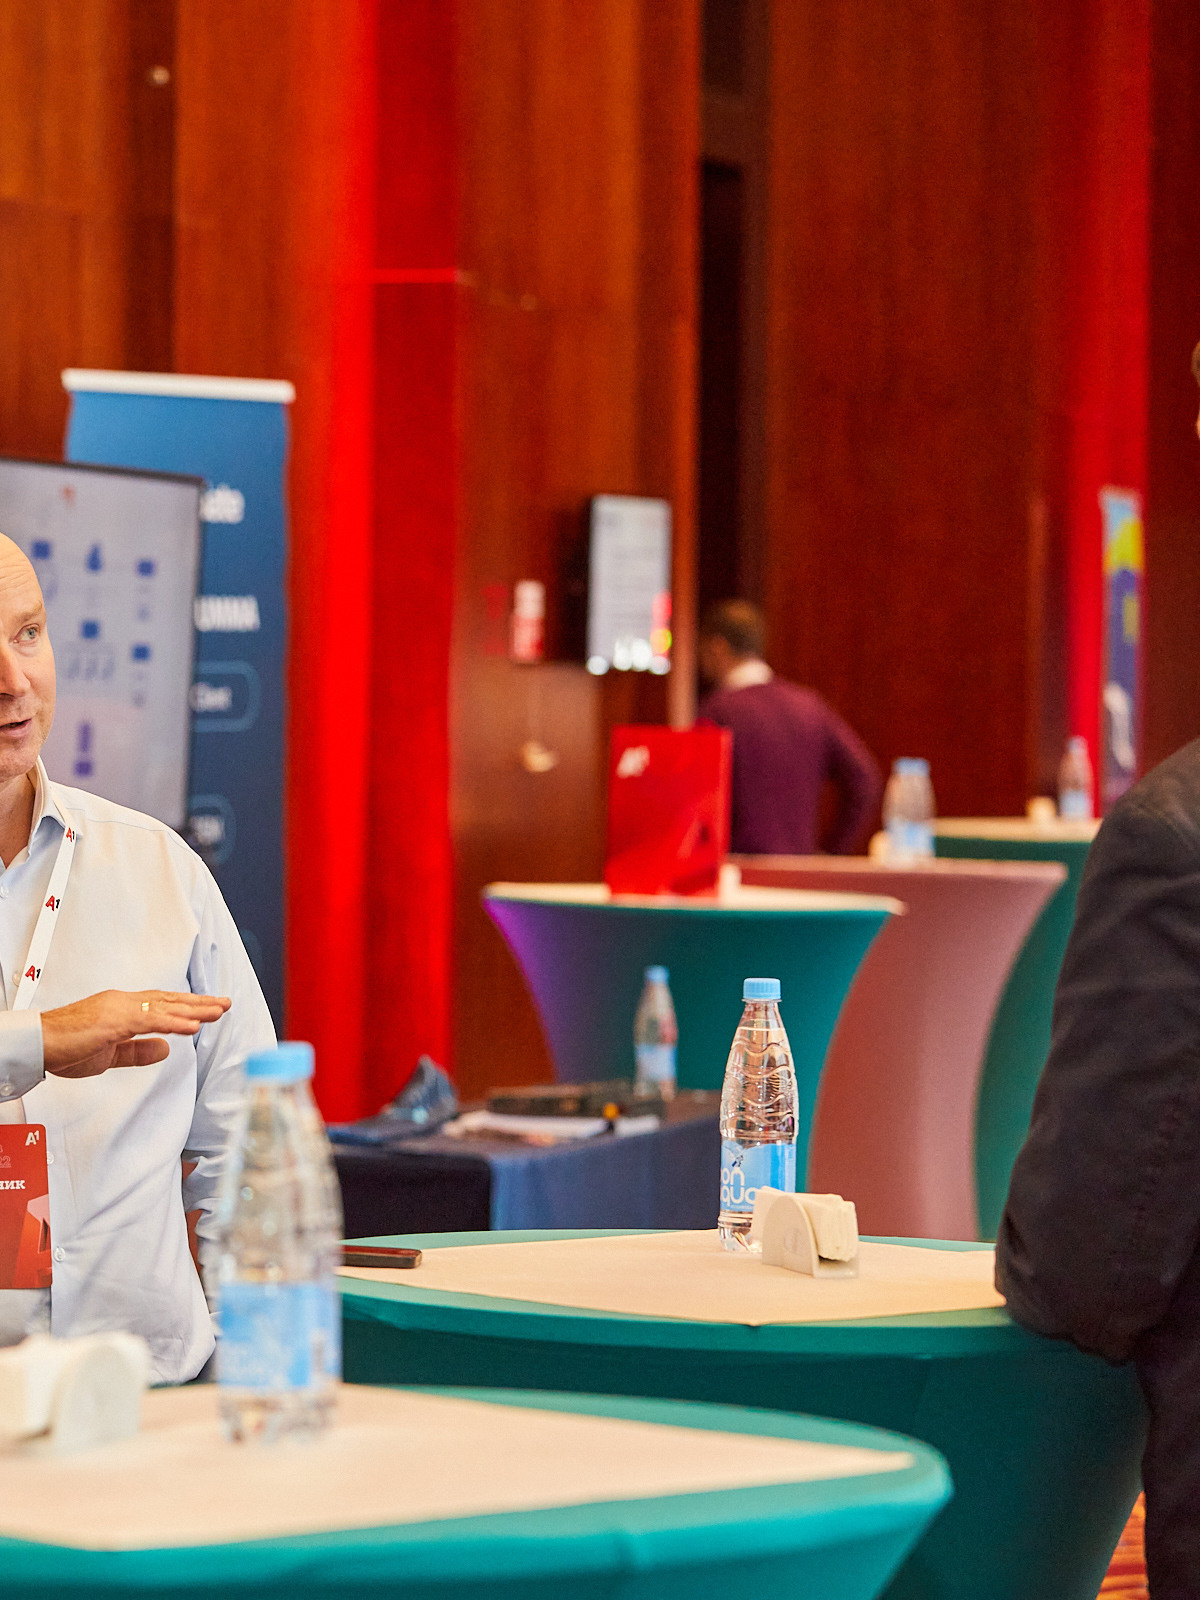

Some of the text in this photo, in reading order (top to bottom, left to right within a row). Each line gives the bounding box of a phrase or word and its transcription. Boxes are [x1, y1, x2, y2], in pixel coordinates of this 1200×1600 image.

[66, 827, 75, 842] A1
[45, 895, 60, 911] A1
[25, 965, 41, 981] A1
[25, 1130, 40, 1146] A1
[721, 1167, 745, 1186] on
